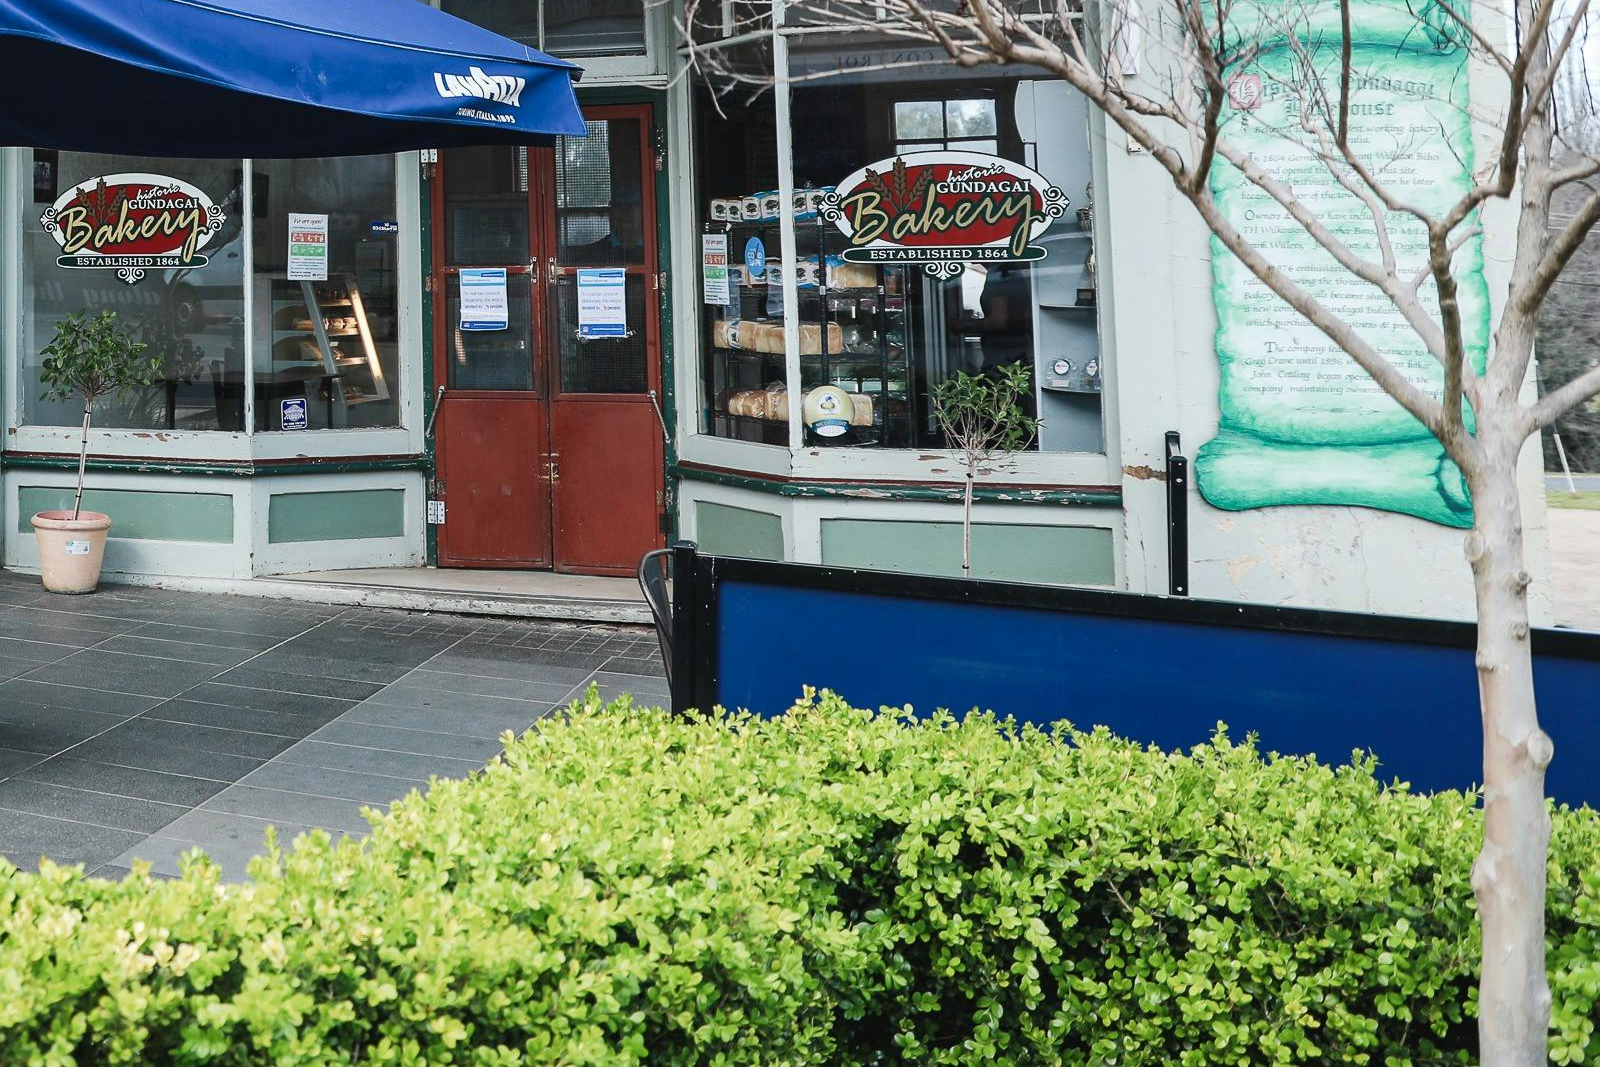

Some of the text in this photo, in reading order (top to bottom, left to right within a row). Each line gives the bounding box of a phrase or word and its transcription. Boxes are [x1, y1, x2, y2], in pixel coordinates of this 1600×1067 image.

[433, 66, 526, 107] LAVAZZA
[947, 163, 1006, 183] historic
[136, 183, 181, 202] historic
[936, 180, 1031, 194] GUNDAGAI
[128, 198, 199, 210] GUNDAGAI
[841, 183, 1045, 257] Bakery
[57, 199, 208, 263] Bakery
[77, 257, 180, 266] ESTABLISHED 1864
[870, 248, 1009, 260] ESTABLISHED 1864
[1277, 264, 1294, 272] 976
